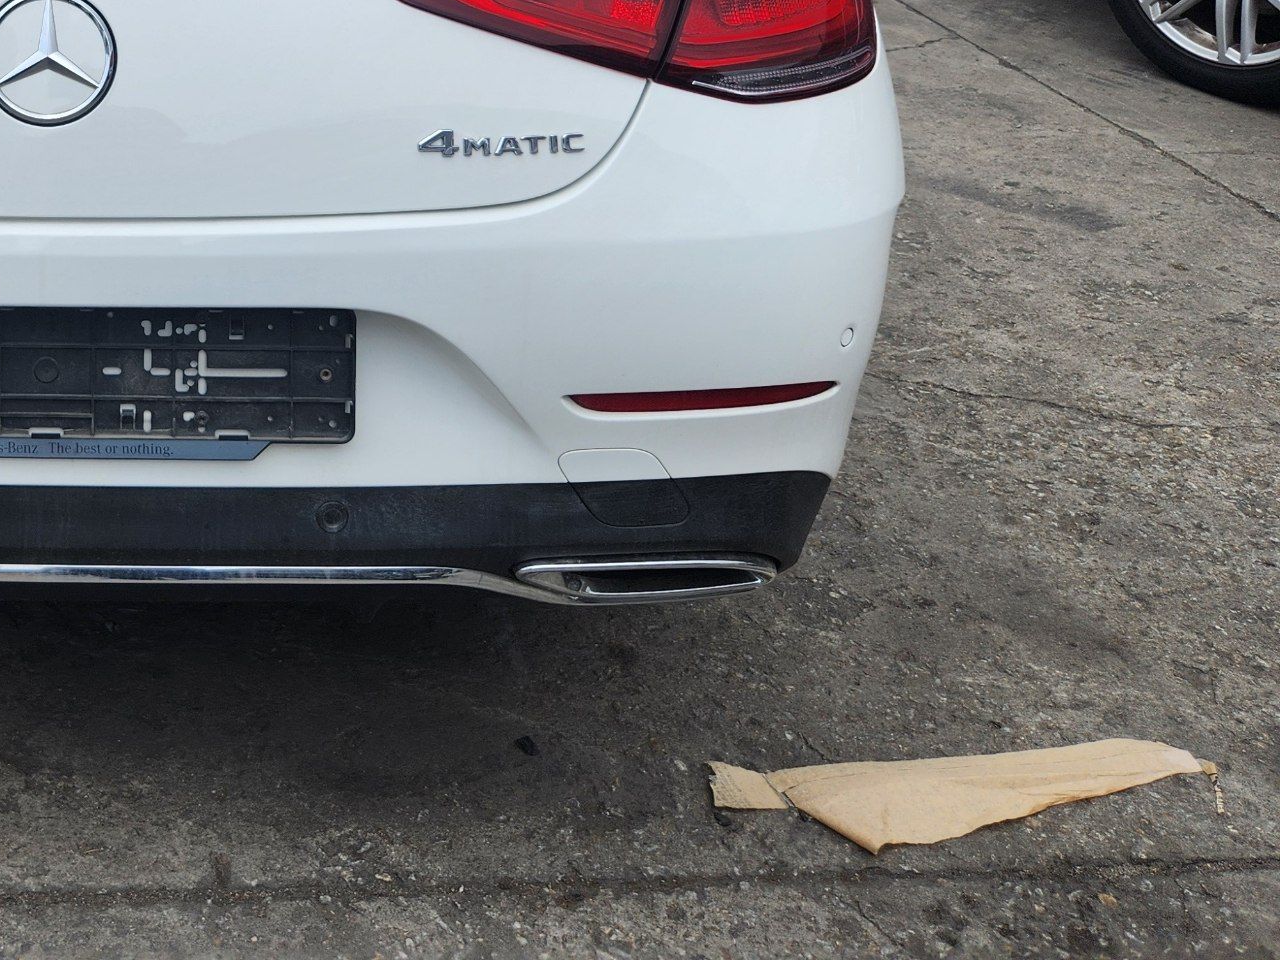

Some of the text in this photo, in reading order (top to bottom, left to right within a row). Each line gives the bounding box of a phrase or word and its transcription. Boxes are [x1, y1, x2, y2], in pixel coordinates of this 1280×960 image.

[418, 129, 585, 157] 4MATIC
[48, 441, 72, 454] The
[75, 442, 101, 455] best
[104, 445, 118, 455] or
[121, 443, 174, 457] nothing.
